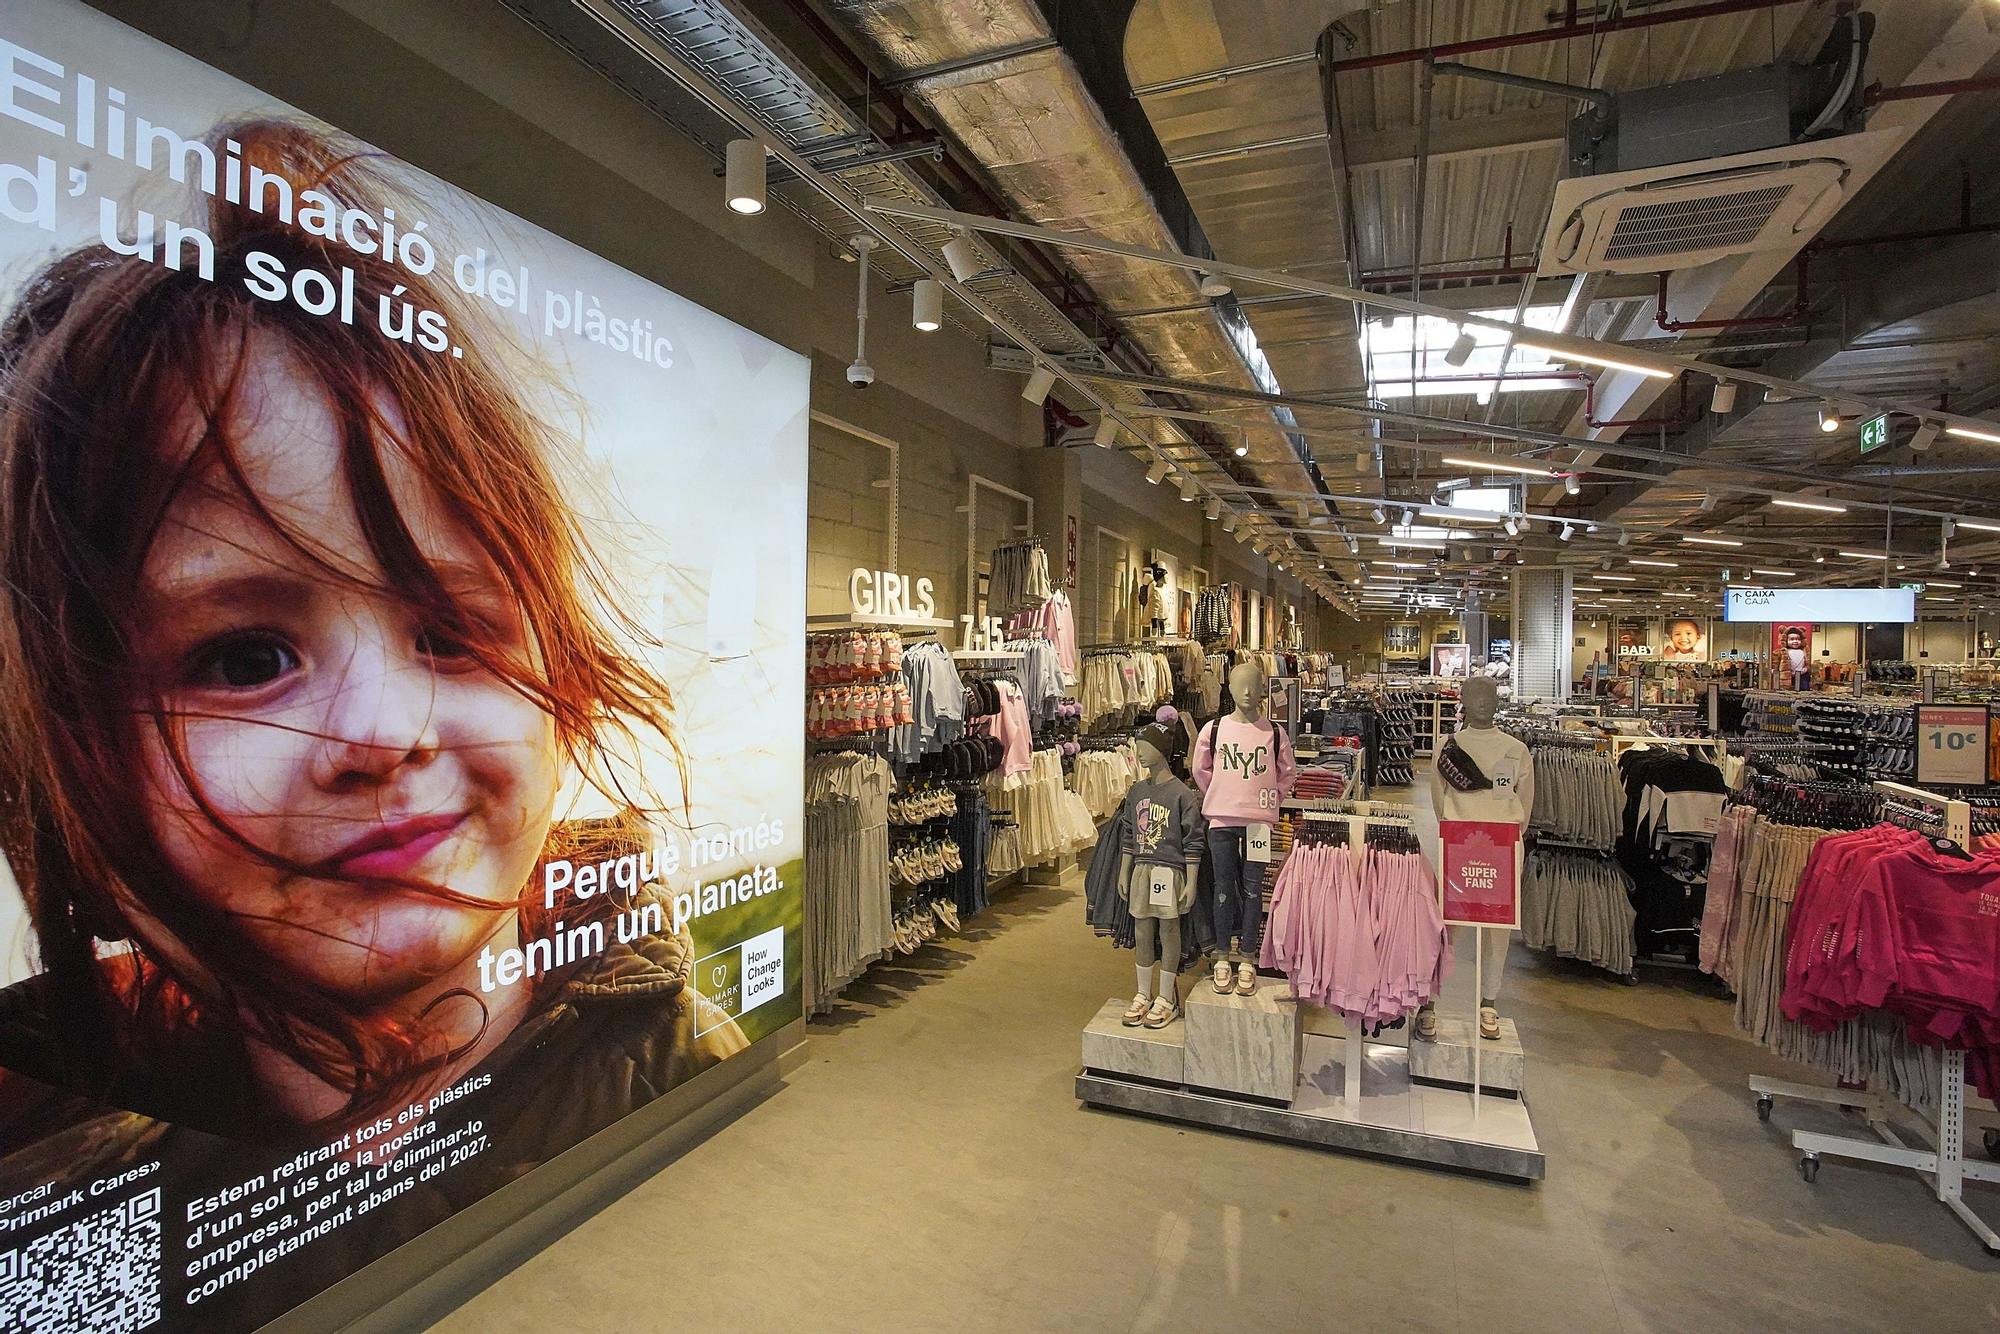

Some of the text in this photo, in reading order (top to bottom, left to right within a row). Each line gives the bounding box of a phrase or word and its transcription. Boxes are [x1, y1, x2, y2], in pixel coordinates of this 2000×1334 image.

[0, 38, 674, 369] Eliminació del plàstic
[0, 155, 463, 360] d’un sol ús.
[851, 567, 935, 619] GIRLS
[1744, 590, 1776, 598] CAIXA
[1744, 597, 1770, 605] CAJA
[960, 614, 1004, 651] 7-15
[1620, 645, 1656, 655] BABY
[1928, 731, 1977, 751] 10€
[1222, 743, 1268, 780] NYC
[1440, 753, 1473, 789] STITCH
[1495, 777, 1511, 786] 12€
[1259, 787, 1278, 809] 89
[1149, 802, 1171, 828] YORK
[1250, 840, 1268, 849] 10€
[545, 811, 784, 909] Perquè només
[1461, 866, 1498, 879] SUPER
[1465, 877, 1494, 889] FANS
[1153, 883, 1167, 894] 9€
[477, 863, 784, 994] tenim un planeta.
[747, 949, 768, 965] How
[747, 957, 781, 981] Change
[700, 985, 738, 1009] PRIMARK
[747, 976, 775, 997] Looks
[186, 1073, 492, 1222] Estem retirant tots els plàstics
[186, 1120, 436, 1250] d’un sol ús de la nostra
[186, 1120, 483, 1277] empresa, per tal d’eliminar-lo
[186, 1135, 492, 1305] completament abans del 2027.
